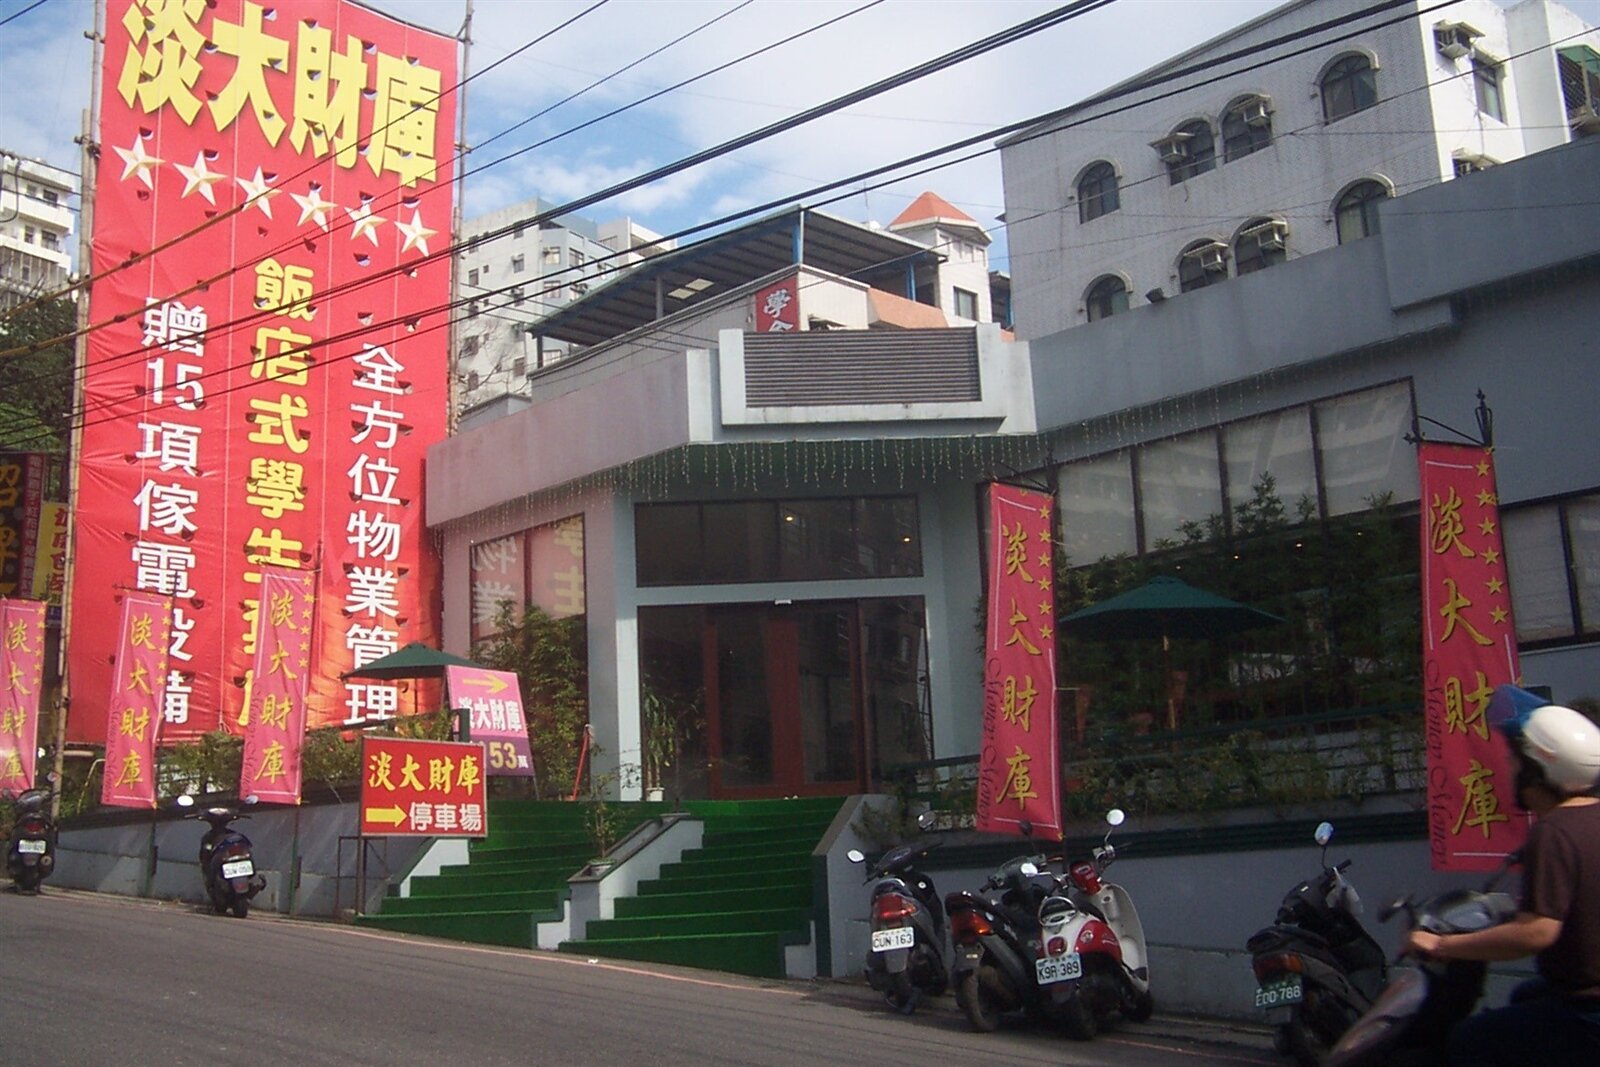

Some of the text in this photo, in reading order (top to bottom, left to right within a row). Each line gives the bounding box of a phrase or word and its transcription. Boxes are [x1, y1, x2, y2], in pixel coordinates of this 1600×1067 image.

[117, 0, 442, 189] 淡大財庫
[238, 258, 315, 727] 飯店式學生
[343, 342, 405, 731] 全方位物業管理
[0, 618, 32, 784] 淡大財庫
[114, 611, 157, 790] 淡大財庫
[254, 588, 299, 785] 淡大財庫
[1430, 486, 1508, 839] 淡大財庫
[368, 751, 481, 796] 淡大財庫
[409, 801, 482, 832] 停車場
